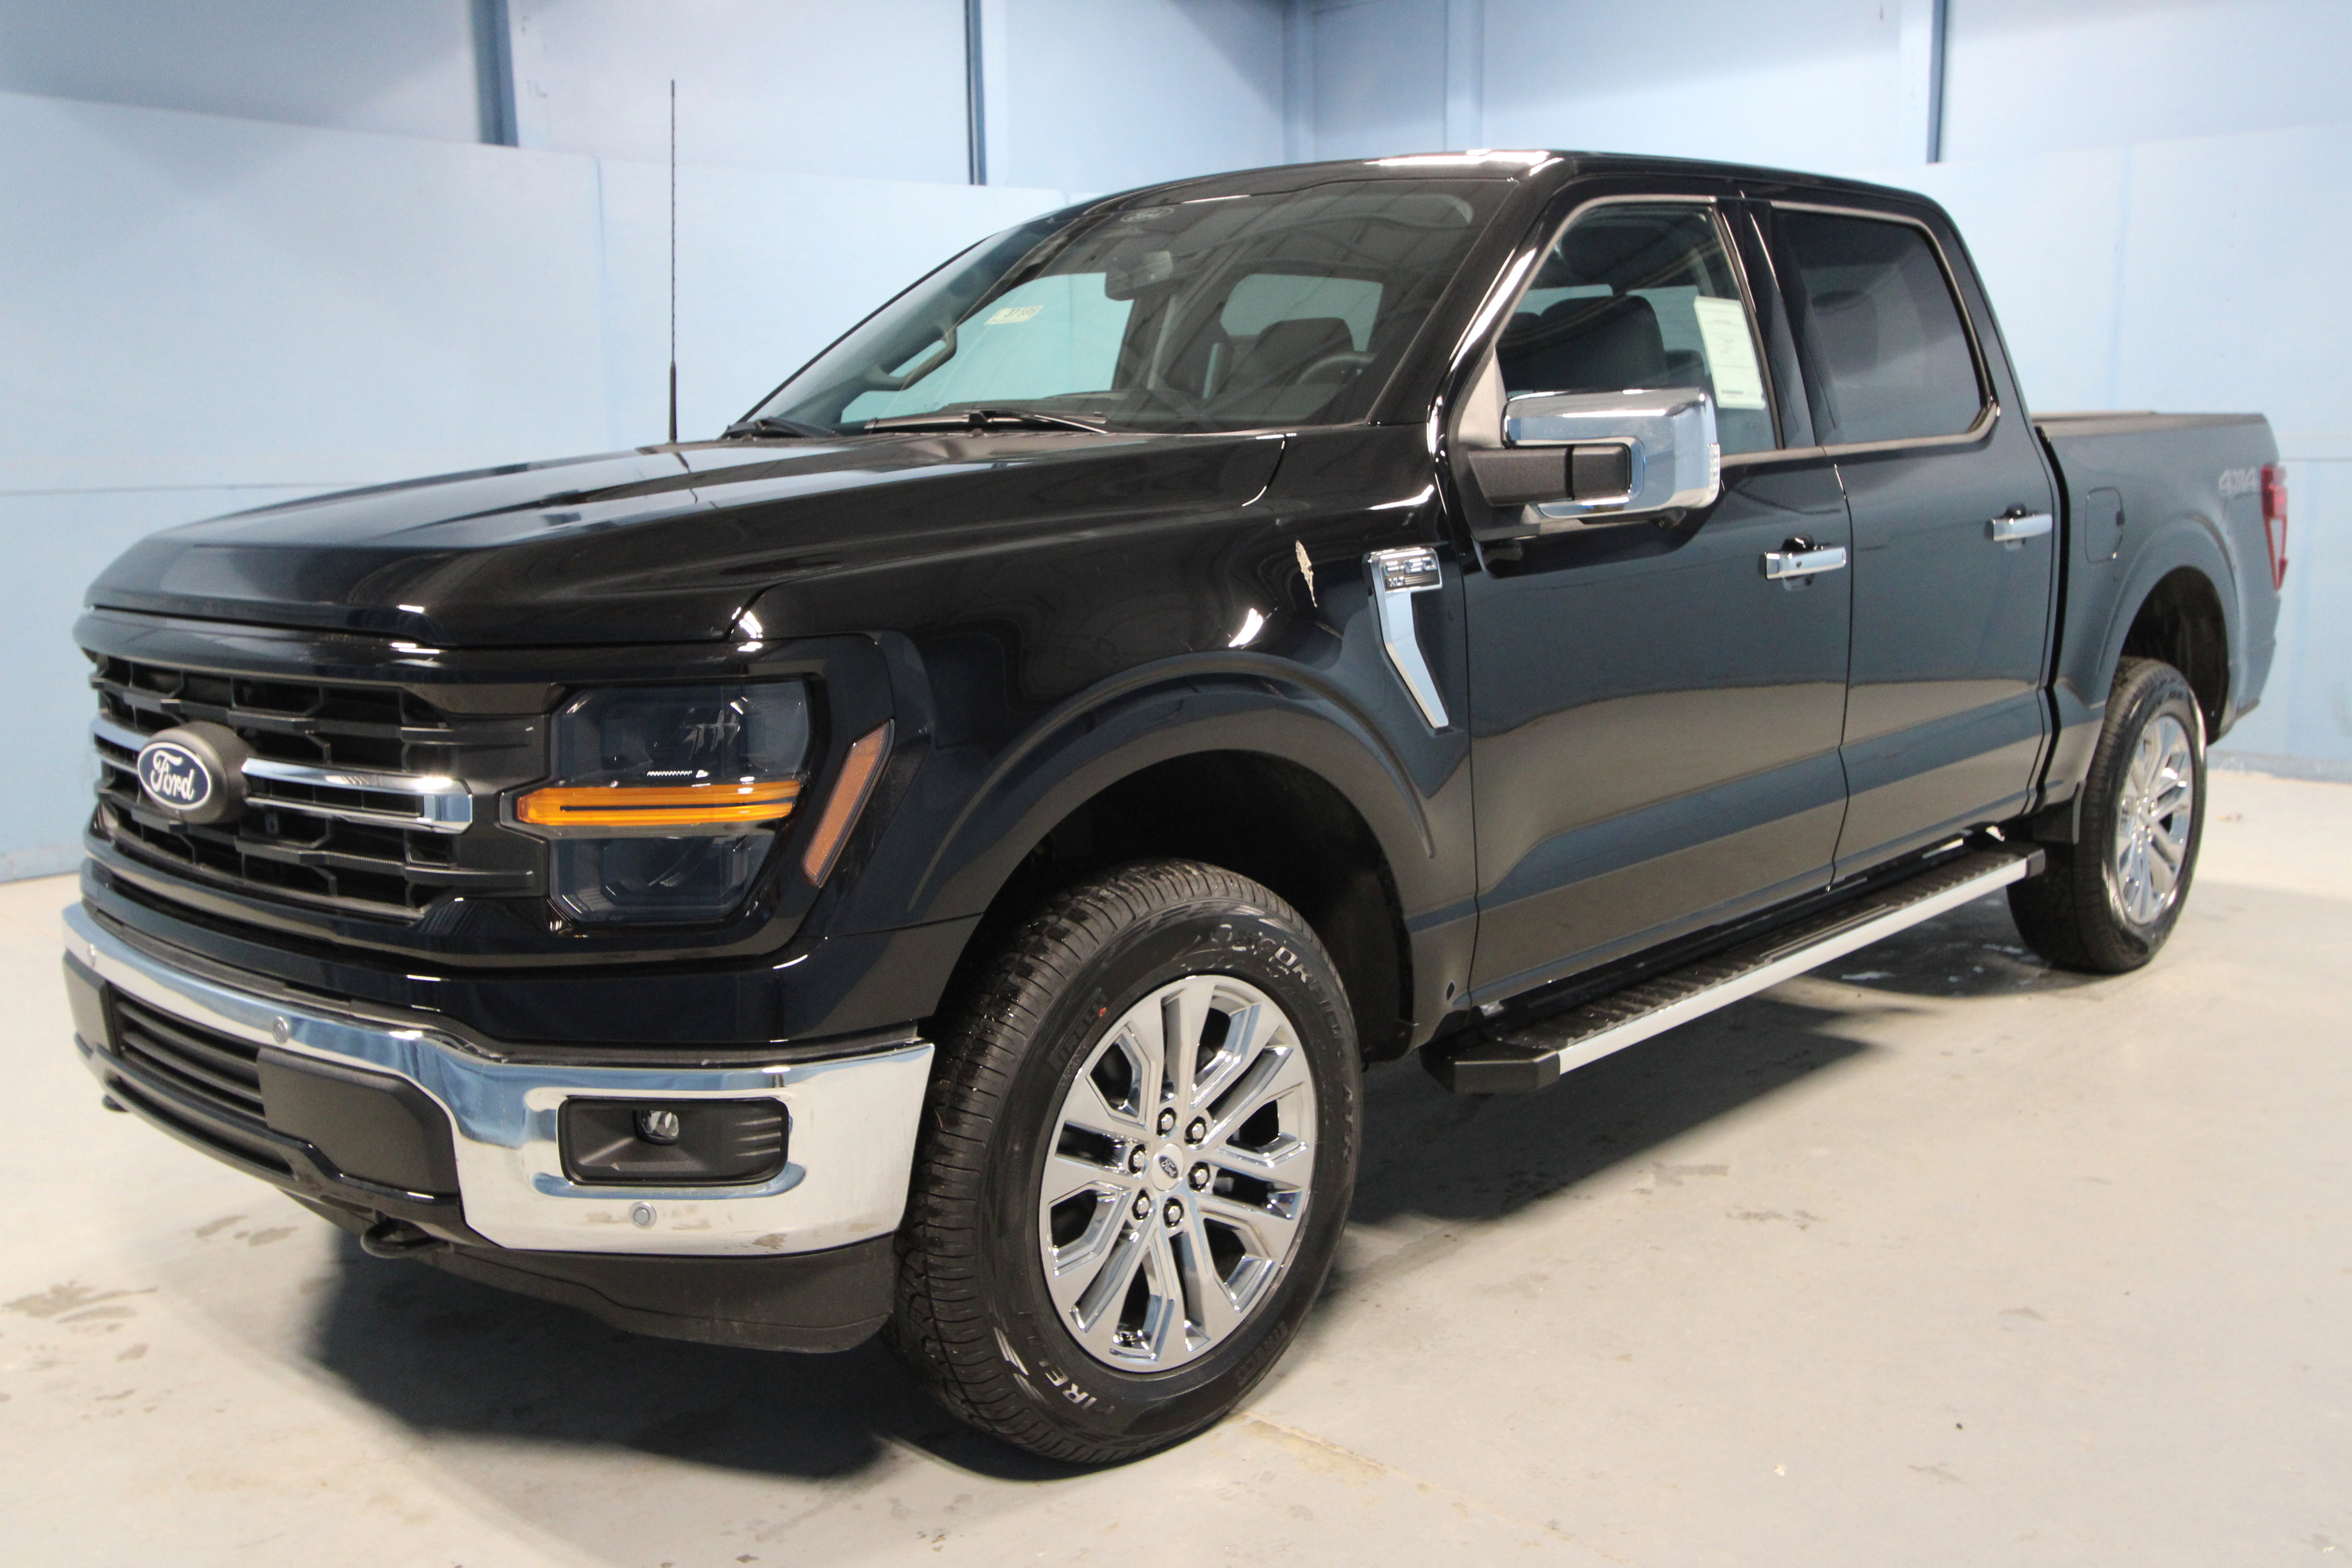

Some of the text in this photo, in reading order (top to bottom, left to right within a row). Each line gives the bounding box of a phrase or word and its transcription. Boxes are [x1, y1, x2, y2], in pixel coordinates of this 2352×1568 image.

[1389, 576, 1404, 588] XLT
[150, 750, 195, 801] Ford
[1161, 1159, 1177, 1177] Ford
